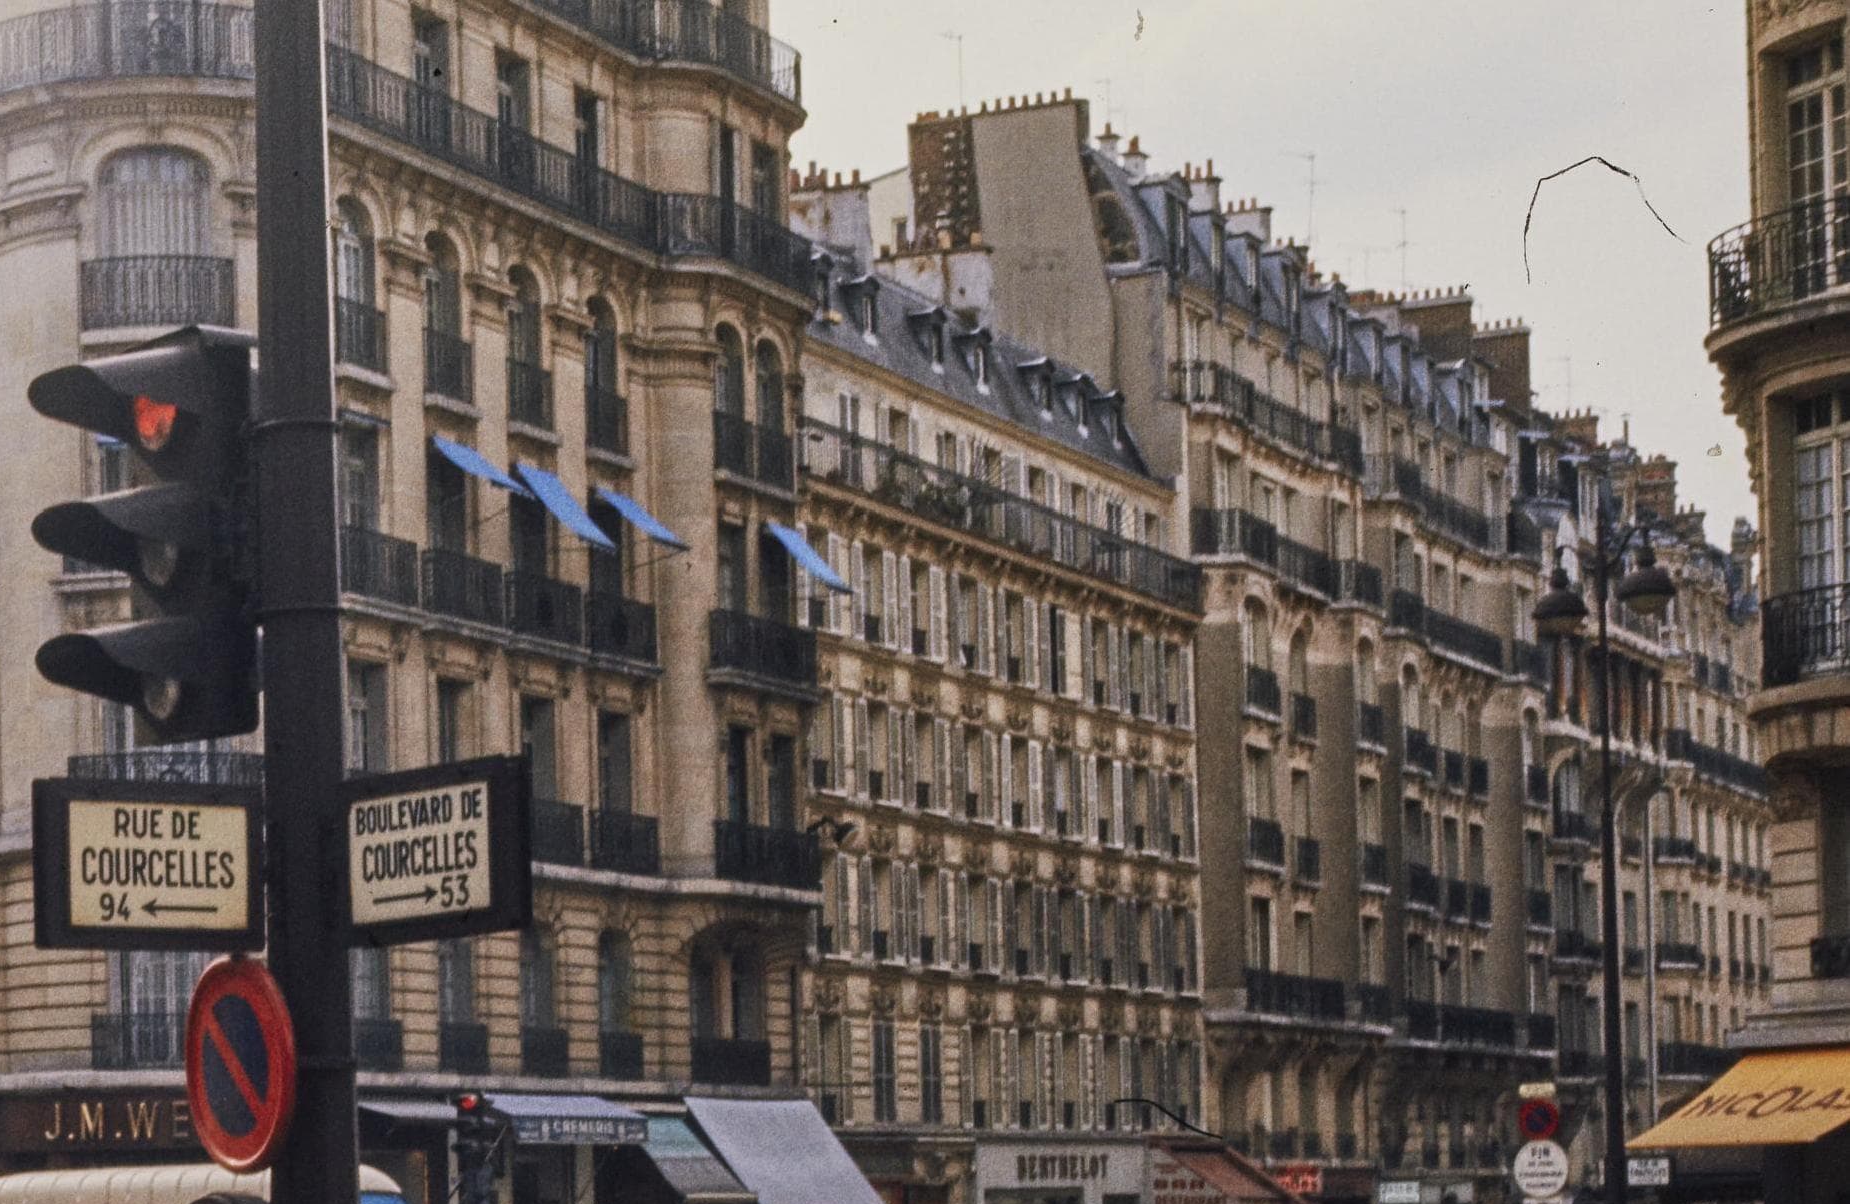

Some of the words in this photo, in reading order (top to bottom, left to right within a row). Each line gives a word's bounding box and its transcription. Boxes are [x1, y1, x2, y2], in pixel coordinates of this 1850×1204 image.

[114, 808, 162, 840] RUE
[172, 809, 201, 841] DE
[355, 798, 451, 836] BOULEVARD
[461, 788, 483, 819] DE
[81, 846, 235, 889] COURCELLES
[362, 830, 478, 882] COURCELLES
[99, 892, 131, 921] 94
[440, 874, 470, 908] 53
[1016, 1153, 1108, 1182] BERTHELOT
